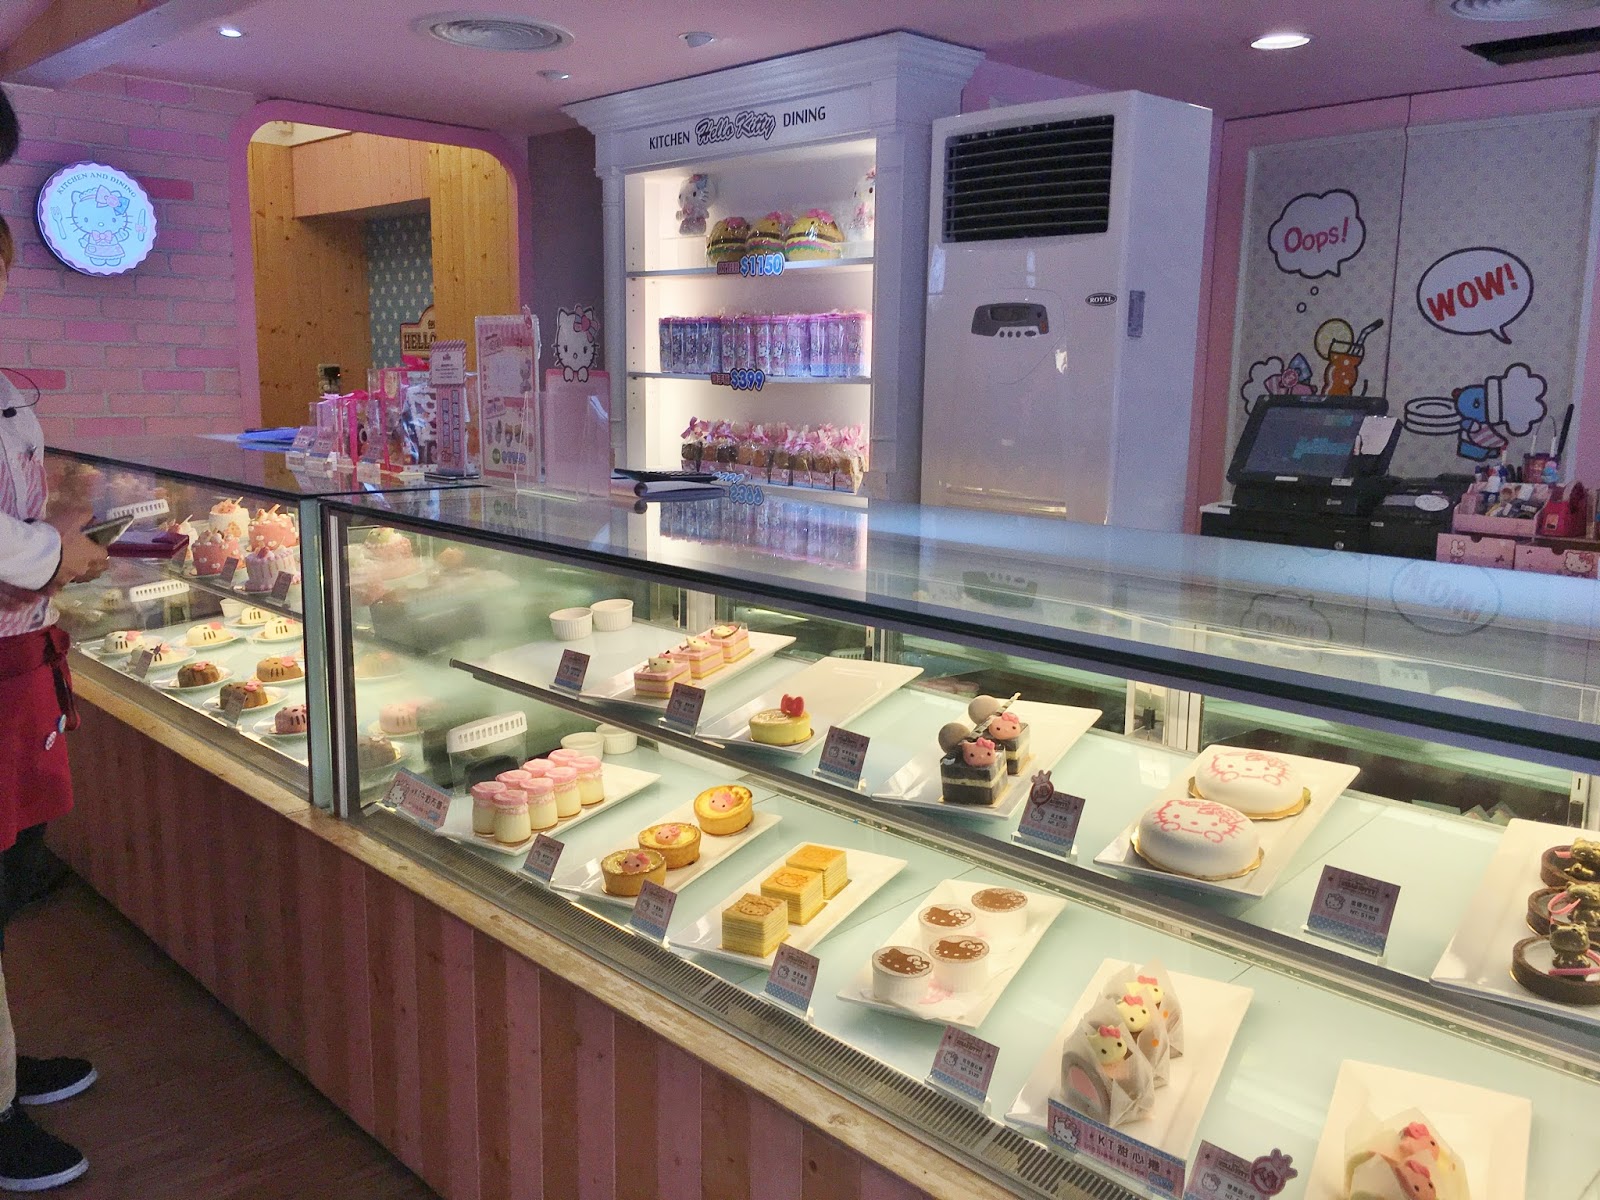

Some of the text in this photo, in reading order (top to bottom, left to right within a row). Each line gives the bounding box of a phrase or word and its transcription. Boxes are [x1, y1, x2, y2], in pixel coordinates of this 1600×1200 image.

[649, 106, 826, 150] KITCHEN Hello Kitty DINING
[56, 172, 137, 198] KITCHEN AND DINING
[1283, 216, 1349, 253] Oops!
[740, 252, 785, 277] $1150
[1426, 262, 1519, 322] WOW!
[730, 368, 765, 391] $399
